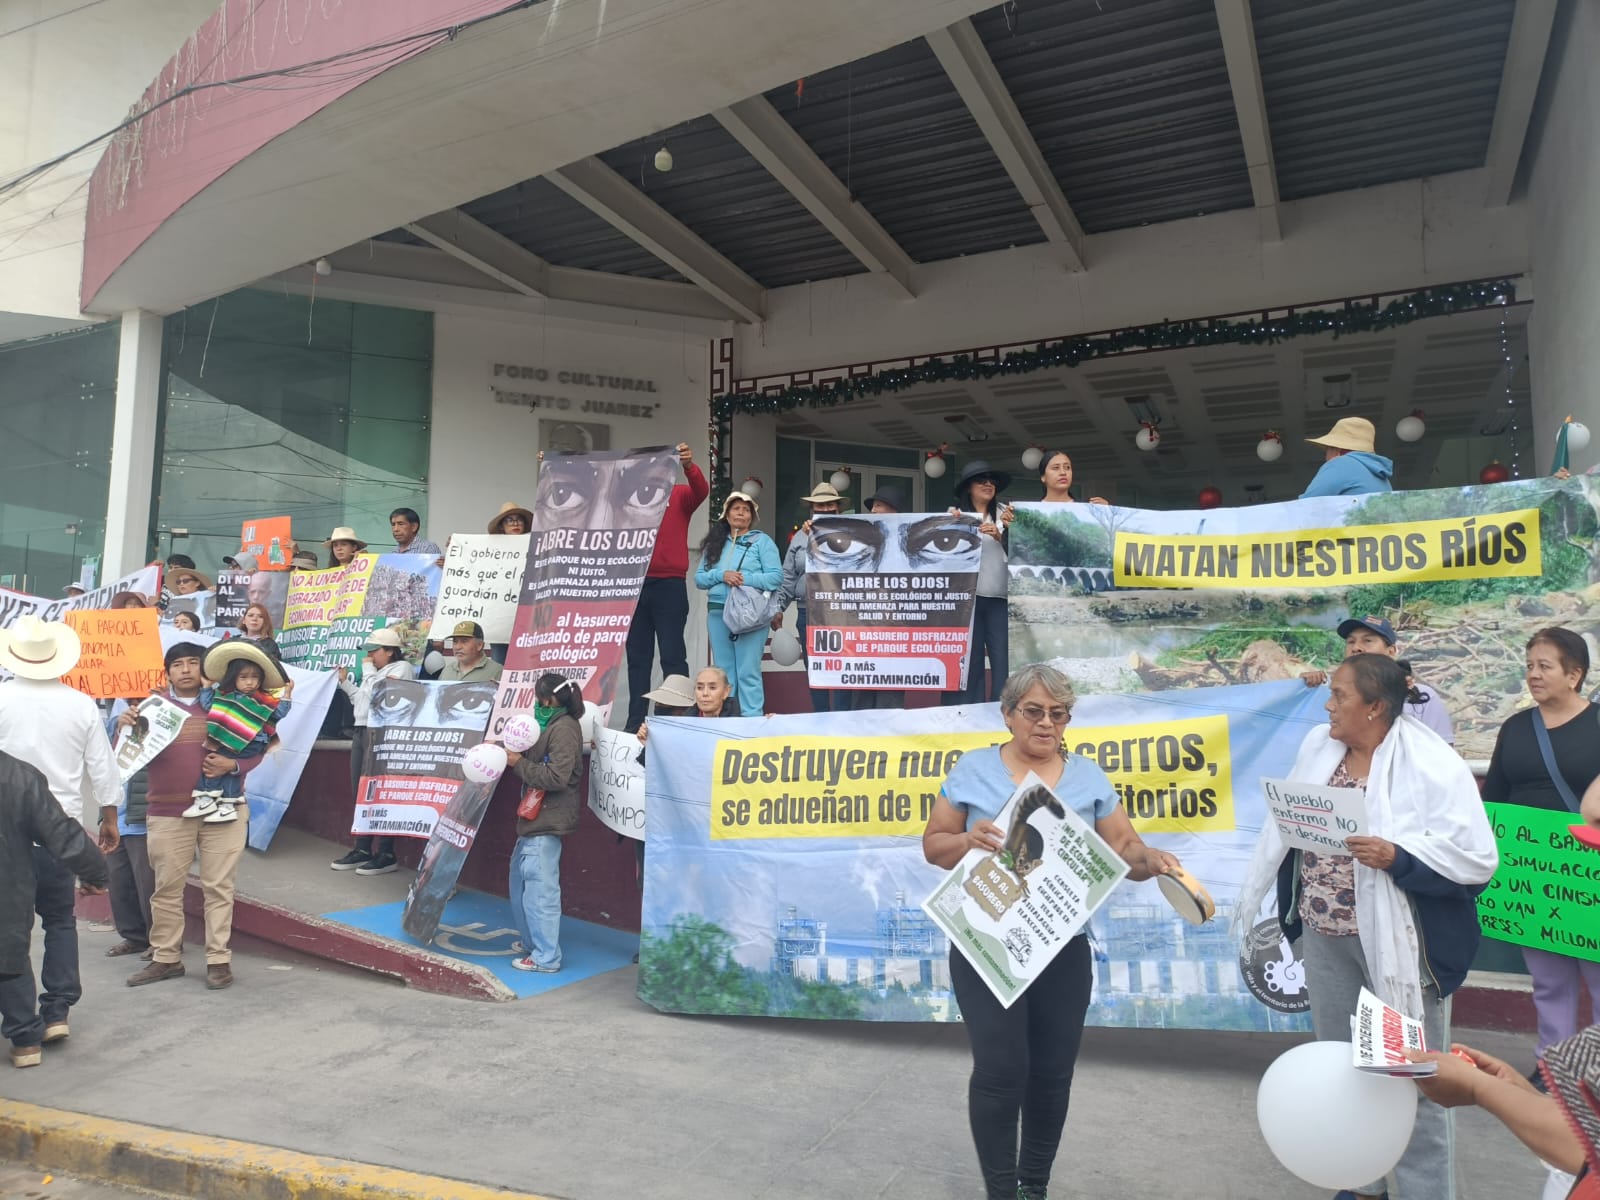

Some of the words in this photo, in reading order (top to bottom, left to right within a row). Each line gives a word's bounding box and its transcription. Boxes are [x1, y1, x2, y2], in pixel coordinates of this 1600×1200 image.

[494, 364, 548, 381] FORO
[558, 371, 657, 392] CULTURAL
[535, 529, 577, 555] ¡ABRE
[580, 531, 613, 550] LOS
[1124, 542, 1237, 577] MATAN
[1251, 533, 1426, 578] NUESTROS
[1441, 518, 1526, 568] RÍOS
[449, 545, 463, 558] El
[470, 547, 520, 564] gobierno
[548, 556, 579, 566] PARQUE
[581, 557, 595, 565] NO
[218, 574, 231, 585] DI
[234, 574, 251, 585] NO
[446, 567, 470, 579] más
[477, 570, 498, 584] que
[505, 566, 517, 579] el
[568, 567, 578, 575] NI
[219, 586, 235, 595] AL
[351, 578, 366, 591] DE
[528, 582, 537, 590] ES
[549, 578, 588, 587] AMENAZA
[592, 578, 613, 587] PARA
[842, 577, 880, 589] ¡ABRE
[884, 577, 908, 588] LOS
[912, 577, 949, 588] OJOS!
[443, 586, 498, 600] guardián
[552, 588, 559, 596] Y
[560, 588, 598, 597] NUESTRO
[600, 588, 640, 597] ENTORNO
[815, 592, 832, 600] ESTE
[835, 592, 864, 600] PARQUE
[866, 592, 876, 600] NO
[879, 592, 888, 600] ES
[890, 591, 932, 600] ECOLÓGICO
[934, 592, 943, 600] NI
[945, 592, 971, 600] JUSTO:
[80, 620, 92, 635] AL
[97, 619, 143, 636] PARQUE
[350, 618, 374, 632] QUE
[557, 612, 571, 627] al
[573, 612, 631, 628] basurero
[516, 631, 571, 648] disfrazado
[574, 629, 591, 644] de
[814, 629, 843, 653] NO
[845, 632, 857, 640] AL
[860, 632, 908, 641] BASURERO
[81, 642, 125, 656] ONOMIA
[540, 644, 598, 664] ecológico
[856, 644, 868, 653] DE
[871, 644, 908, 653] PARQUE
[911, 642, 963, 654] ECOLÓGICO
[813, 662, 821, 670] DI
[825, 659, 842, 671] NO
[845, 662, 852, 670] A
[854, 660, 875, 670] MÁS
[79, 675, 96, 696] AL
[508, 671, 518, 683] EL
[521, 671, 530, 683] 14
[841, 673, 940, 685] CONTAMINACIÓN
[501, 688, 516, 708] DI
[515, 687, 536, 708] NO
[413, 731, 432, 742] LOS
[434, 732, 464, 743] OJOS!
[722, 746, 888, 786] Destruyen
[388, 792, 413, 800] PARQUE
[1266, 782, 1280, 801] El
[1284, 793, 1333, 811] pueblo
[722, 798, 750, 826] se
[759, 789, 869, 824] adueñan
[879, 790, 911, 821] de
[1336, 816, 1357, 833] NO
[1074, 835, 1086, 848] AL
[1279, 824, 1291, 834] es
[1296, 825, 1348, 848] desarrol
[1516, 826, 1539, 844] AL
[1059, 834, 1072, 848] DE
[1068, 844, 1106, 884] ECONOMÍA
[986, 869, 1001, 884] NO
[997, 882, 1010, 896] AL
[1509, 878, 1532, 894] UN
[970, 874, 1007, 914] BASURERO
[1504, 901, 1535, 919] VAN
[1549, 907, 1561, 920] X
[1541, 925, 1600, 950] MILLON
[1360, 1003, 1373, 1051] DICIEMBRE
